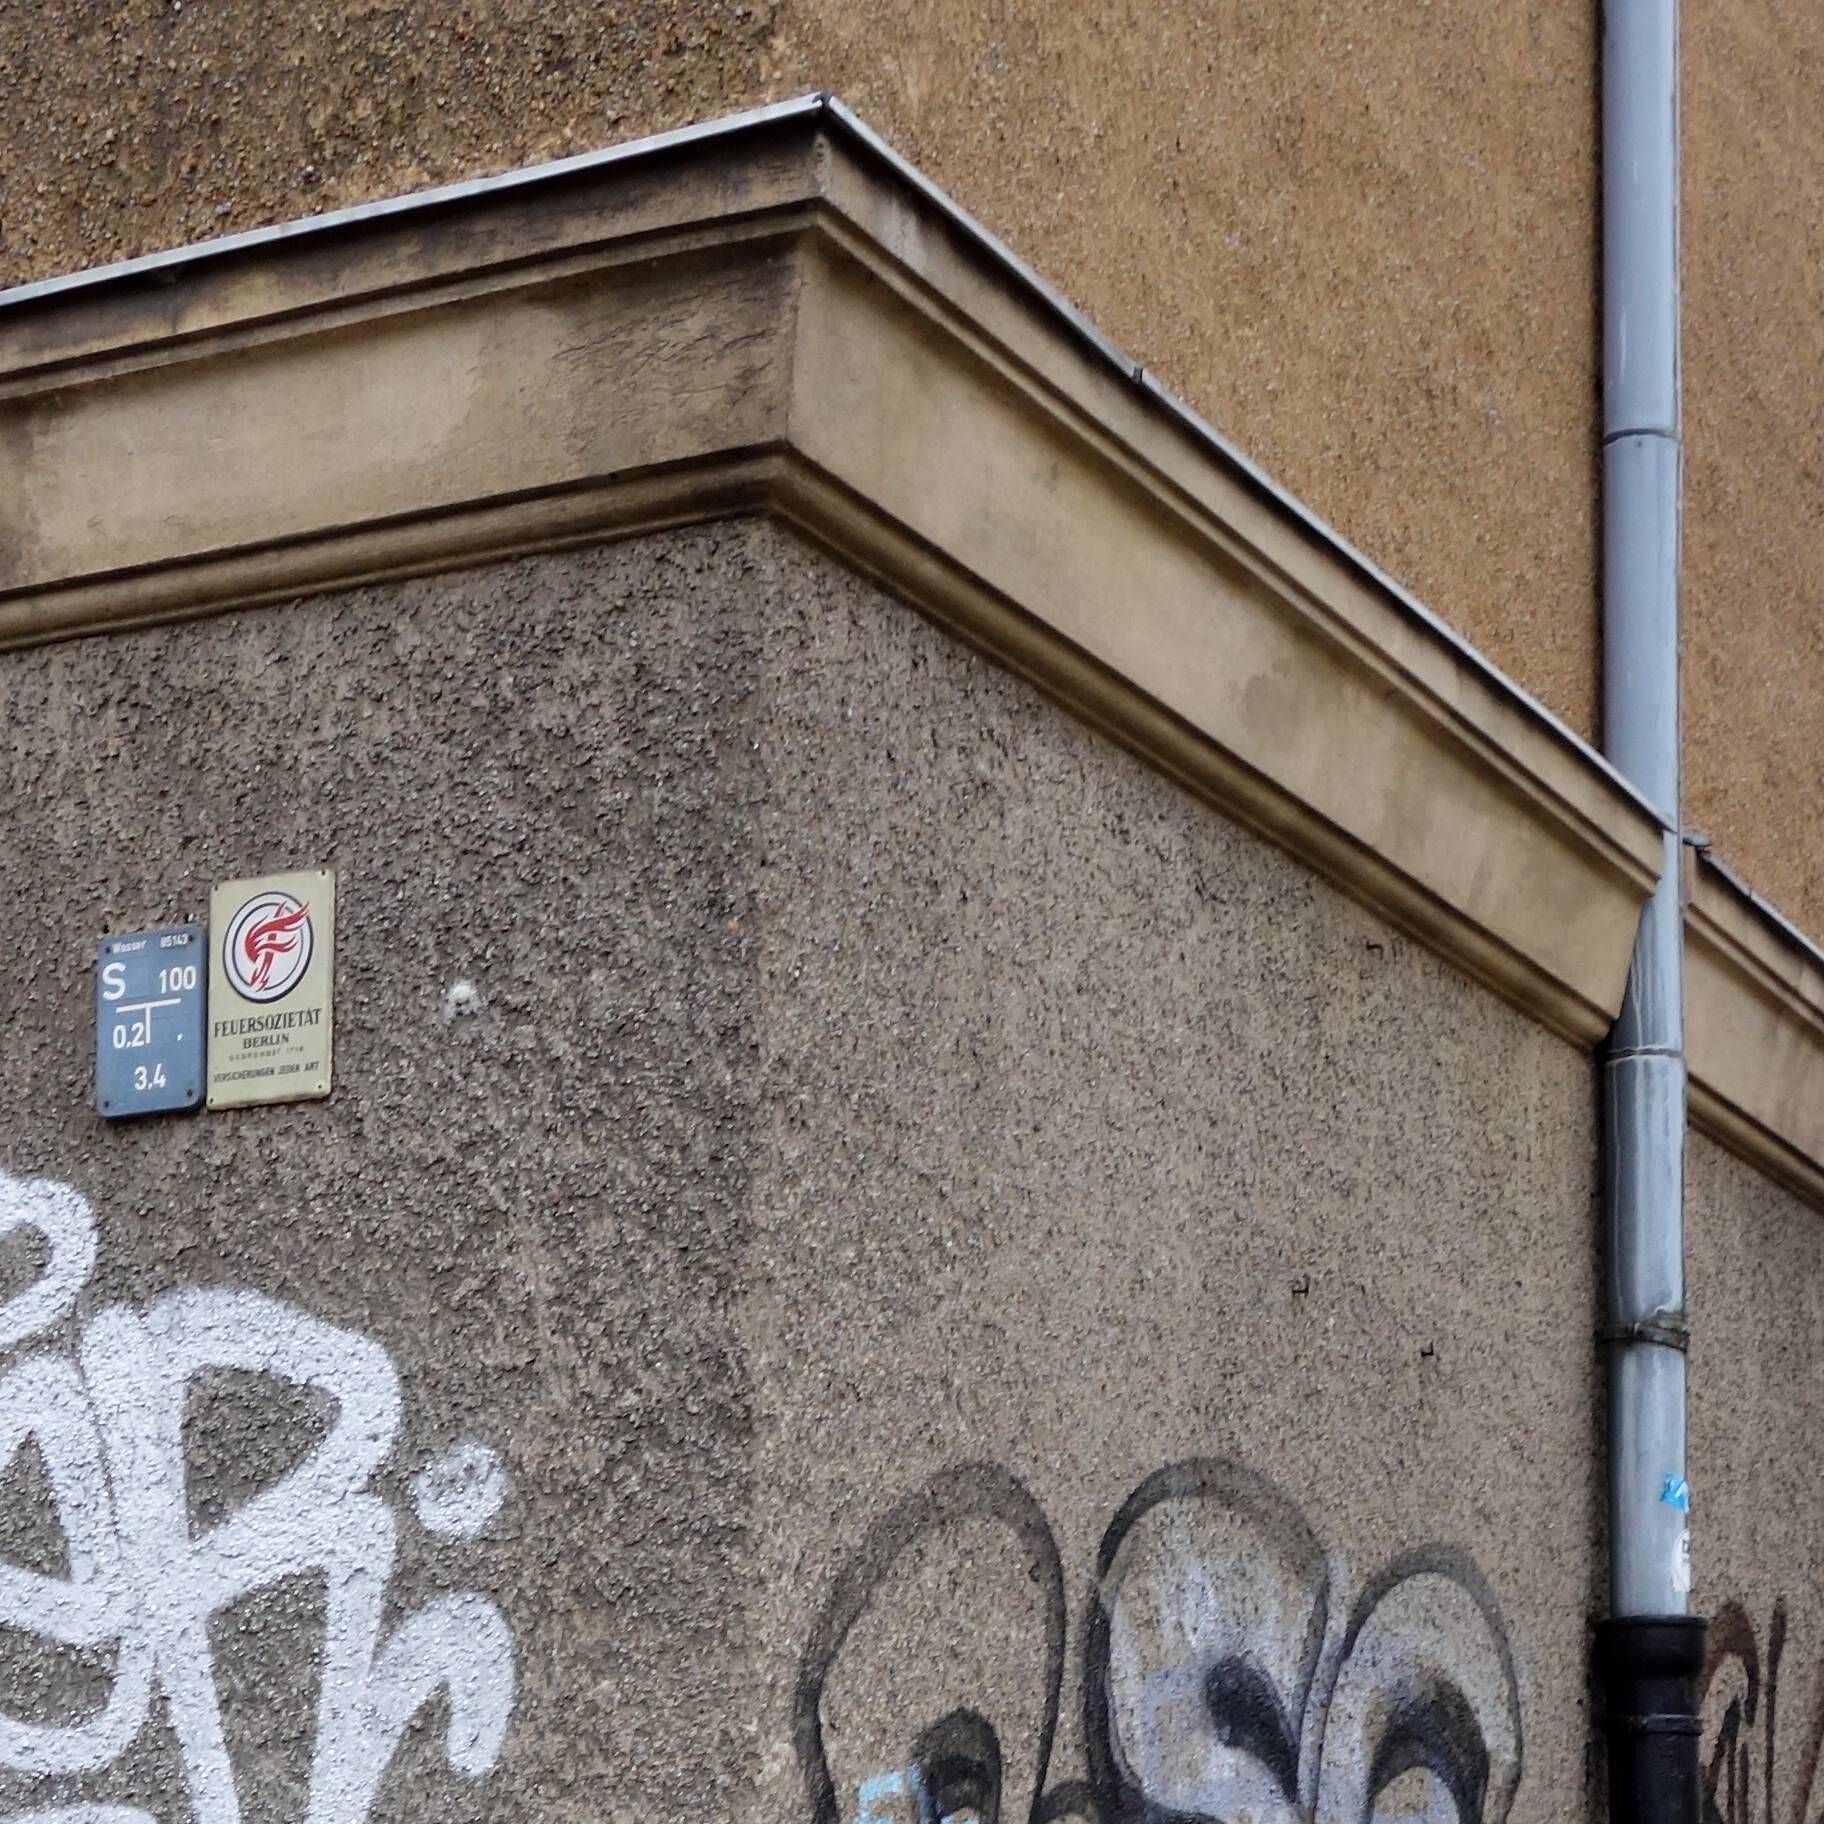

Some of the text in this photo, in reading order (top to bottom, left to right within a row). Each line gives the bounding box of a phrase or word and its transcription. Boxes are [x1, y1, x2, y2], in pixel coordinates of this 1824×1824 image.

[102, 961, 197, 1001] S 100
[243, 1033, 290, 1049] BERLIN
